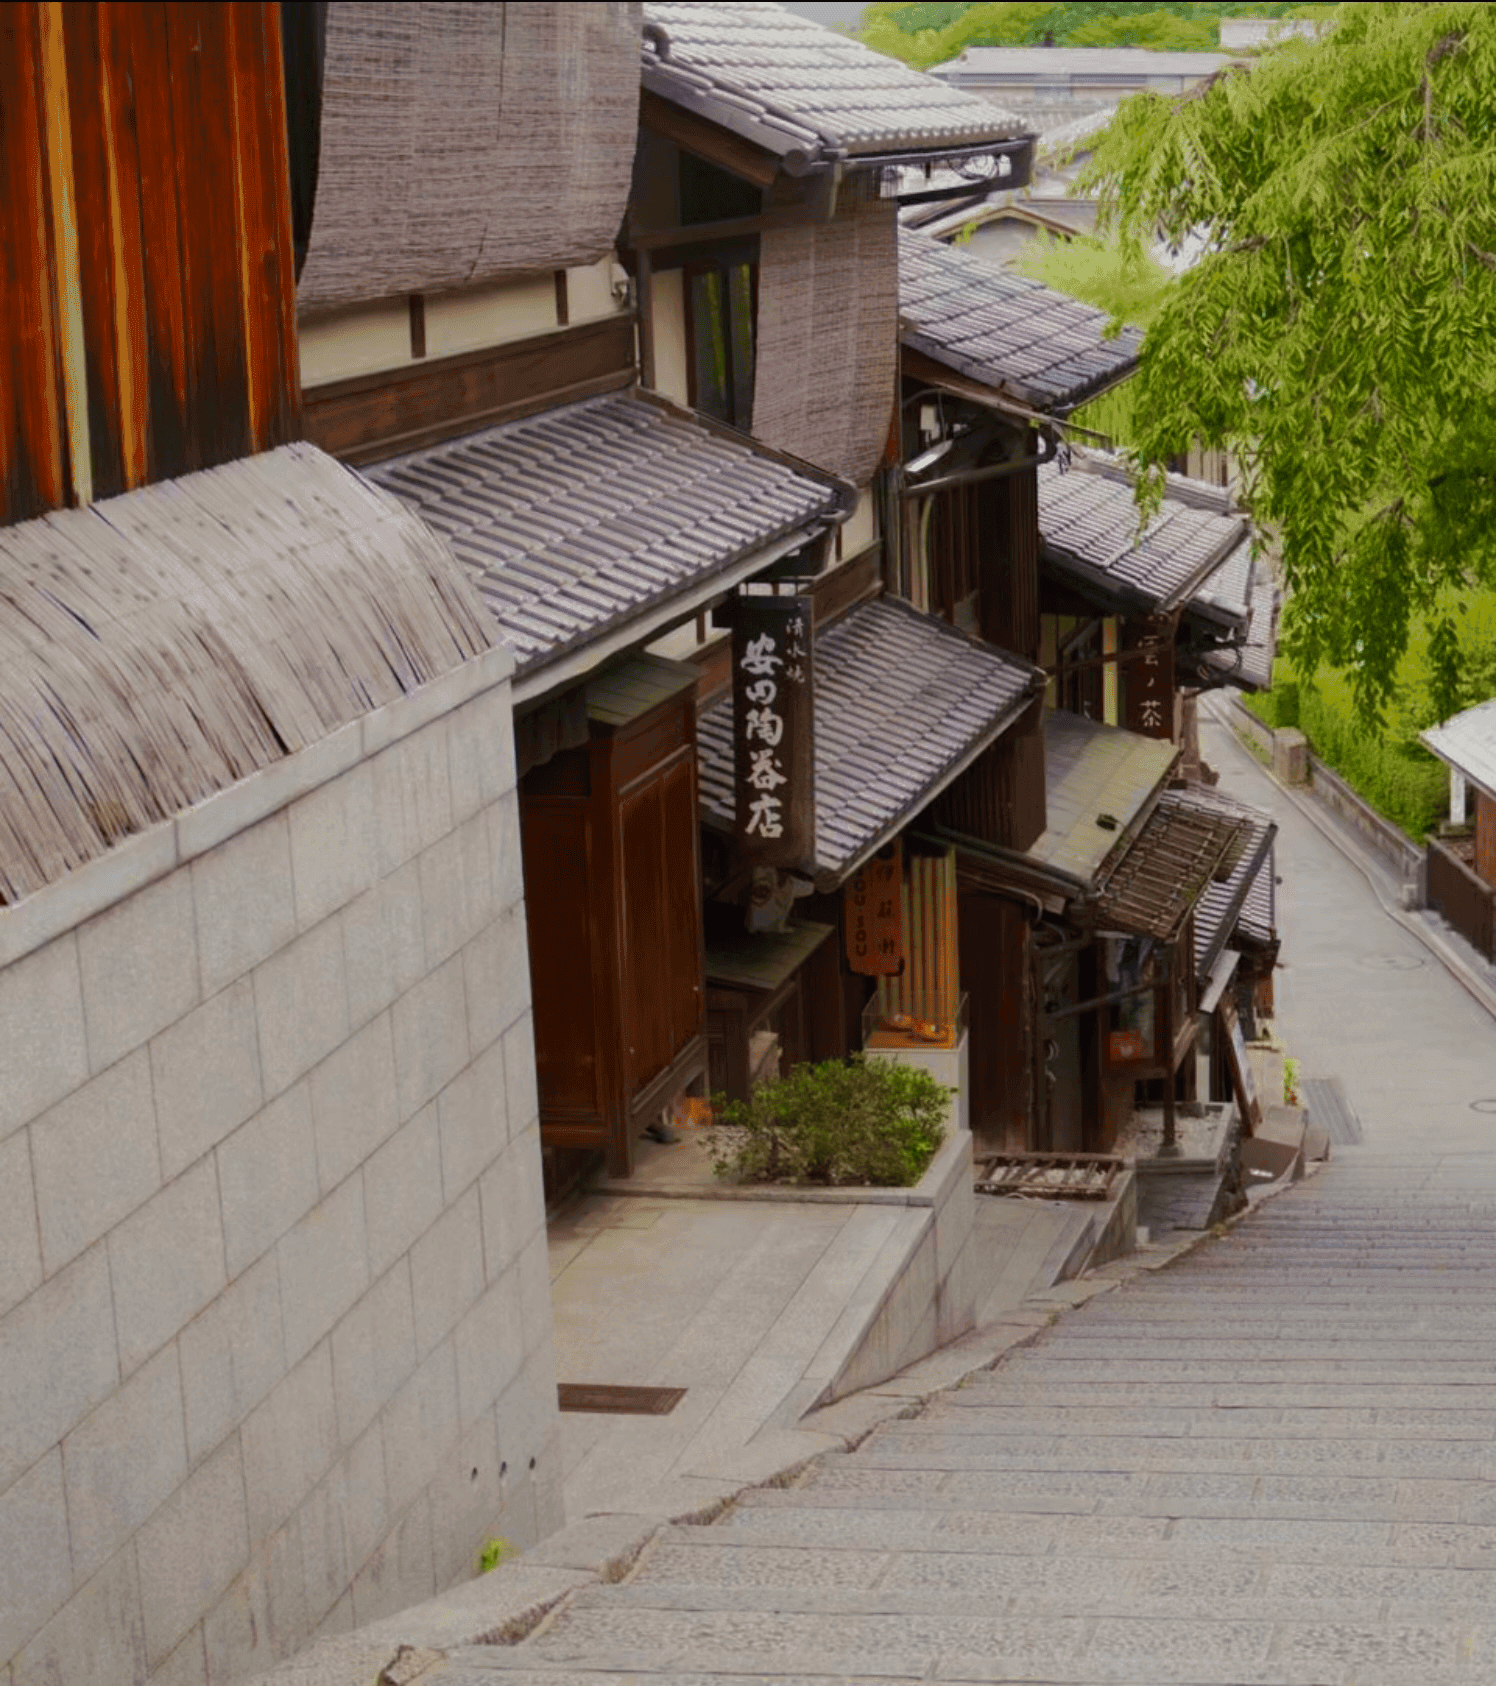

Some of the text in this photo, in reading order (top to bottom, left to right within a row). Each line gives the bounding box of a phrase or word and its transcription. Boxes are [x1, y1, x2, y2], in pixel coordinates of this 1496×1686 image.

[741, 632, 787, 838] 安田陶器店
